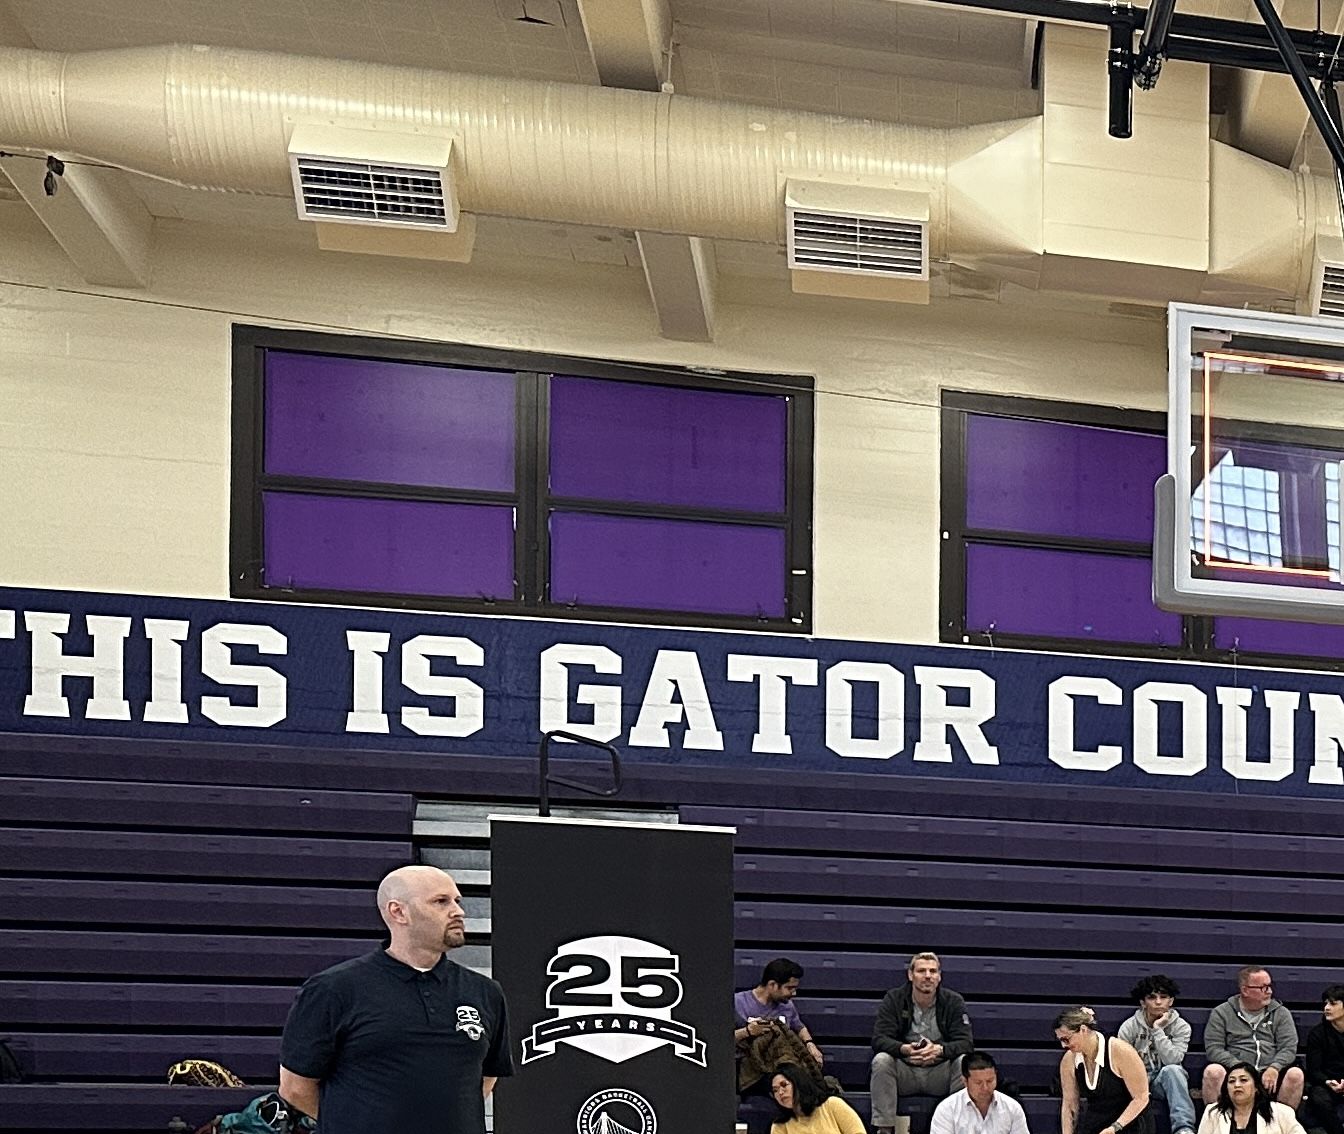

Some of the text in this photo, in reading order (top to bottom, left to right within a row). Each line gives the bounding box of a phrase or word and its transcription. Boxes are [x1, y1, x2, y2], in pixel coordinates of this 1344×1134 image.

[0, 609, 288, 728] HIS
[344, 629, 486, 738] IS
[538, 643, 999, 767] GATOR
[547, 953, 682, 1009] 25
[457, 1009, 480, 1021] 25
[576, 1018, 656, 1034] YEARS
